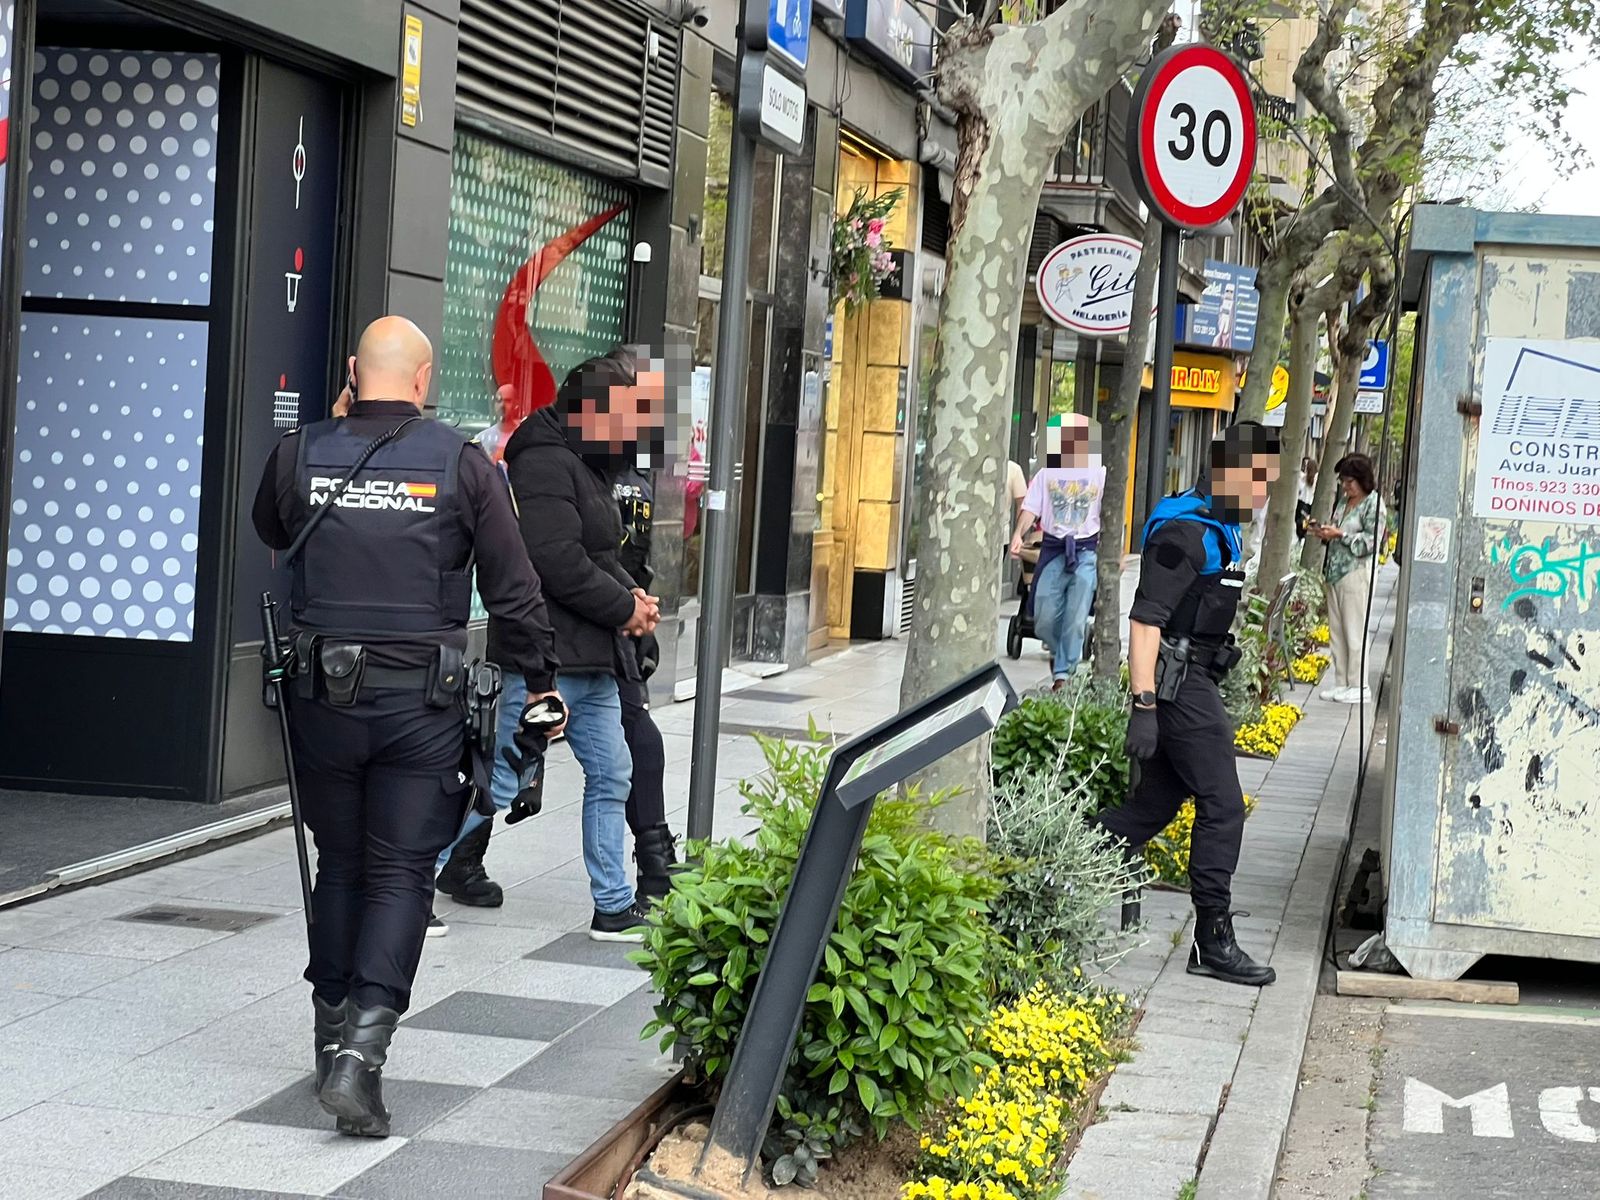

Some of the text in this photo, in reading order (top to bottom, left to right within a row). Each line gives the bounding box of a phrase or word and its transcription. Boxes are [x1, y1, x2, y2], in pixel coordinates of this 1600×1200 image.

[1167, 102, 1232, 167] 30
[1070, 247, 1132, 261] PASTELERÍA
[1072, 309, 1128, 322] HELADERÍA
[1509, 441, 1599, 460] CONSTR
[1499, 459, 1551, 474] Avda.
[1572, 483, 1600, 496] 330
[1491, 494, 1577, 515] DOÑINOS
